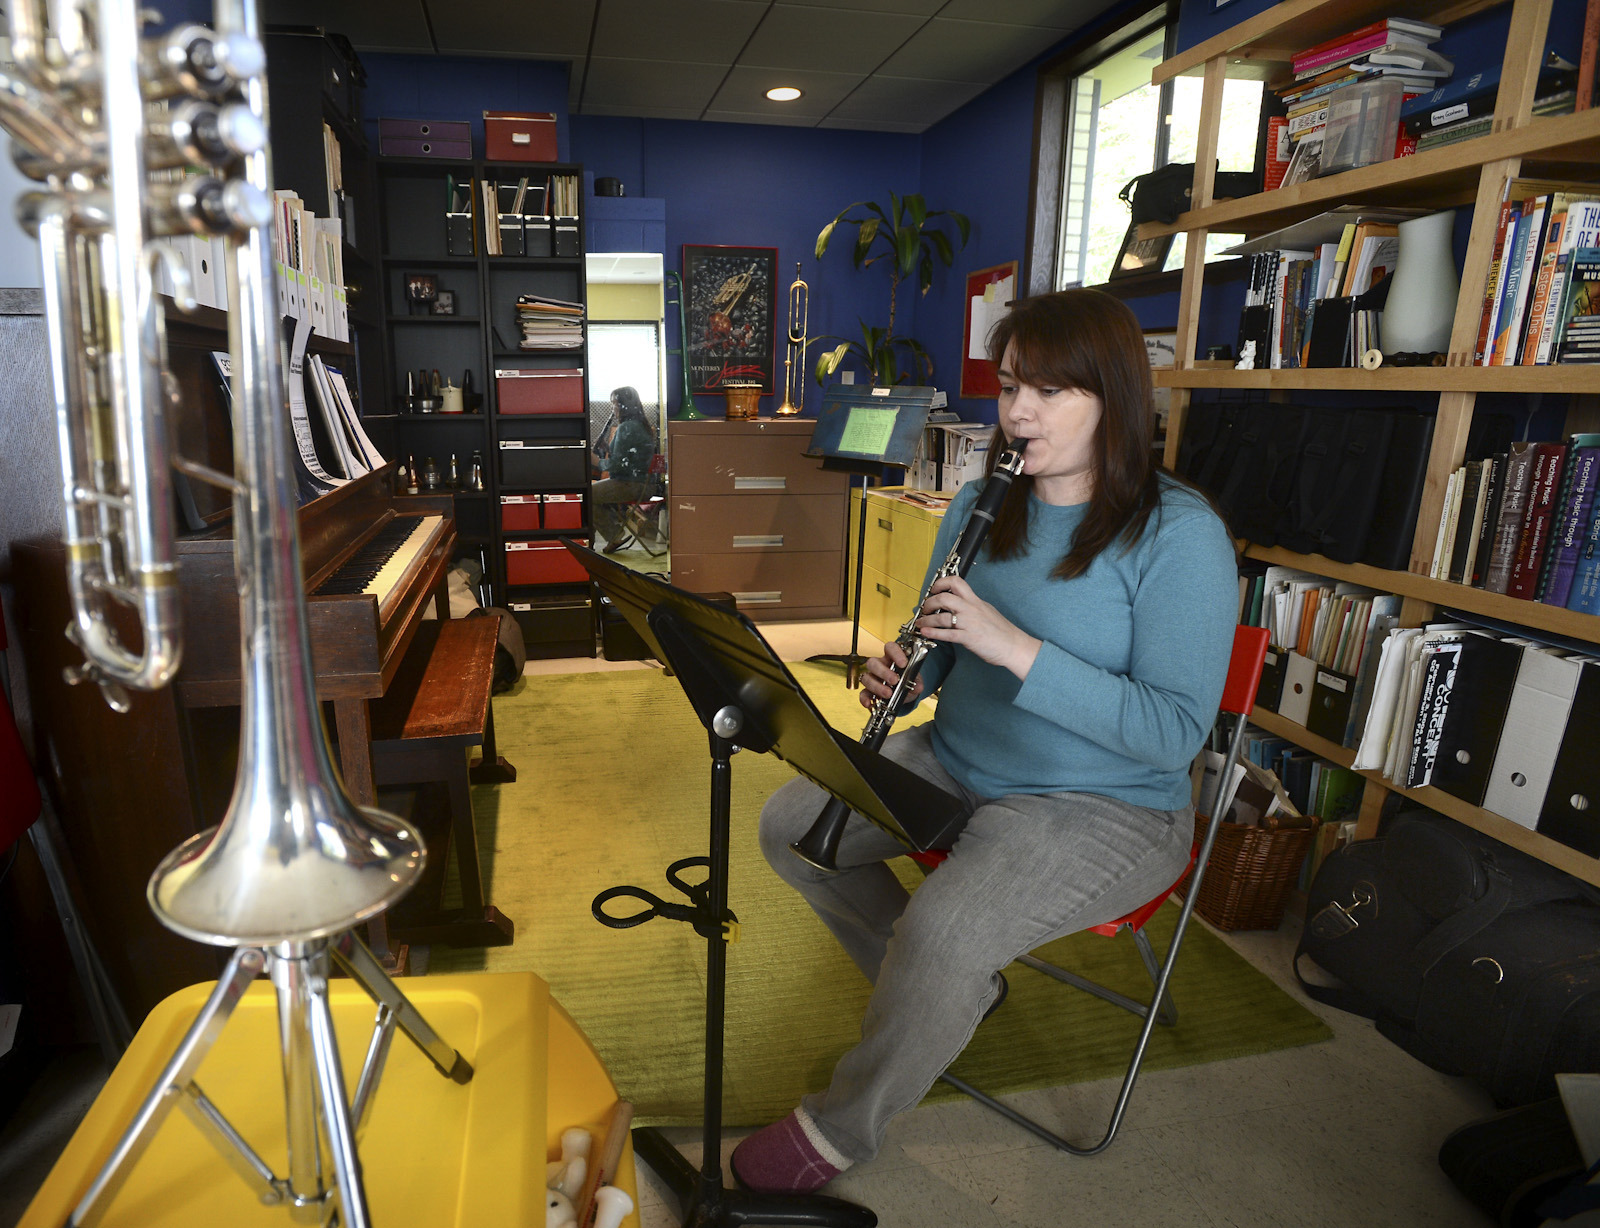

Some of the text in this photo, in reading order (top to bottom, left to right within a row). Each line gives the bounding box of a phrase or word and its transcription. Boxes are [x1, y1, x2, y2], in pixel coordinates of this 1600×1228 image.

[1526, 230, 1537, 262] LISTEN
[1488, 243, 1504, 292] EXPERIENCE
[1506, 268, 1521, 298] Music
[1554, 277, 1563, 287] THE
[1529, 265, 1555, 335] Listen to This
[1547, 288, 1561, 318] ENJOYMENT
[1541, 327, 1551, 344] MUSIC
[1511, 461, 1527, 510] Teaching Music
[1534, 454, 1545, 481] through
[1542, 455, 1559, 505] Teaching Music
[1526, 481, 1540, 522] Performance
[1565, 456, 1594, 548] Teaching Music through
[1426, 663, 1440, 701] February
[1422, 683, 1445, 759] CONCERT
